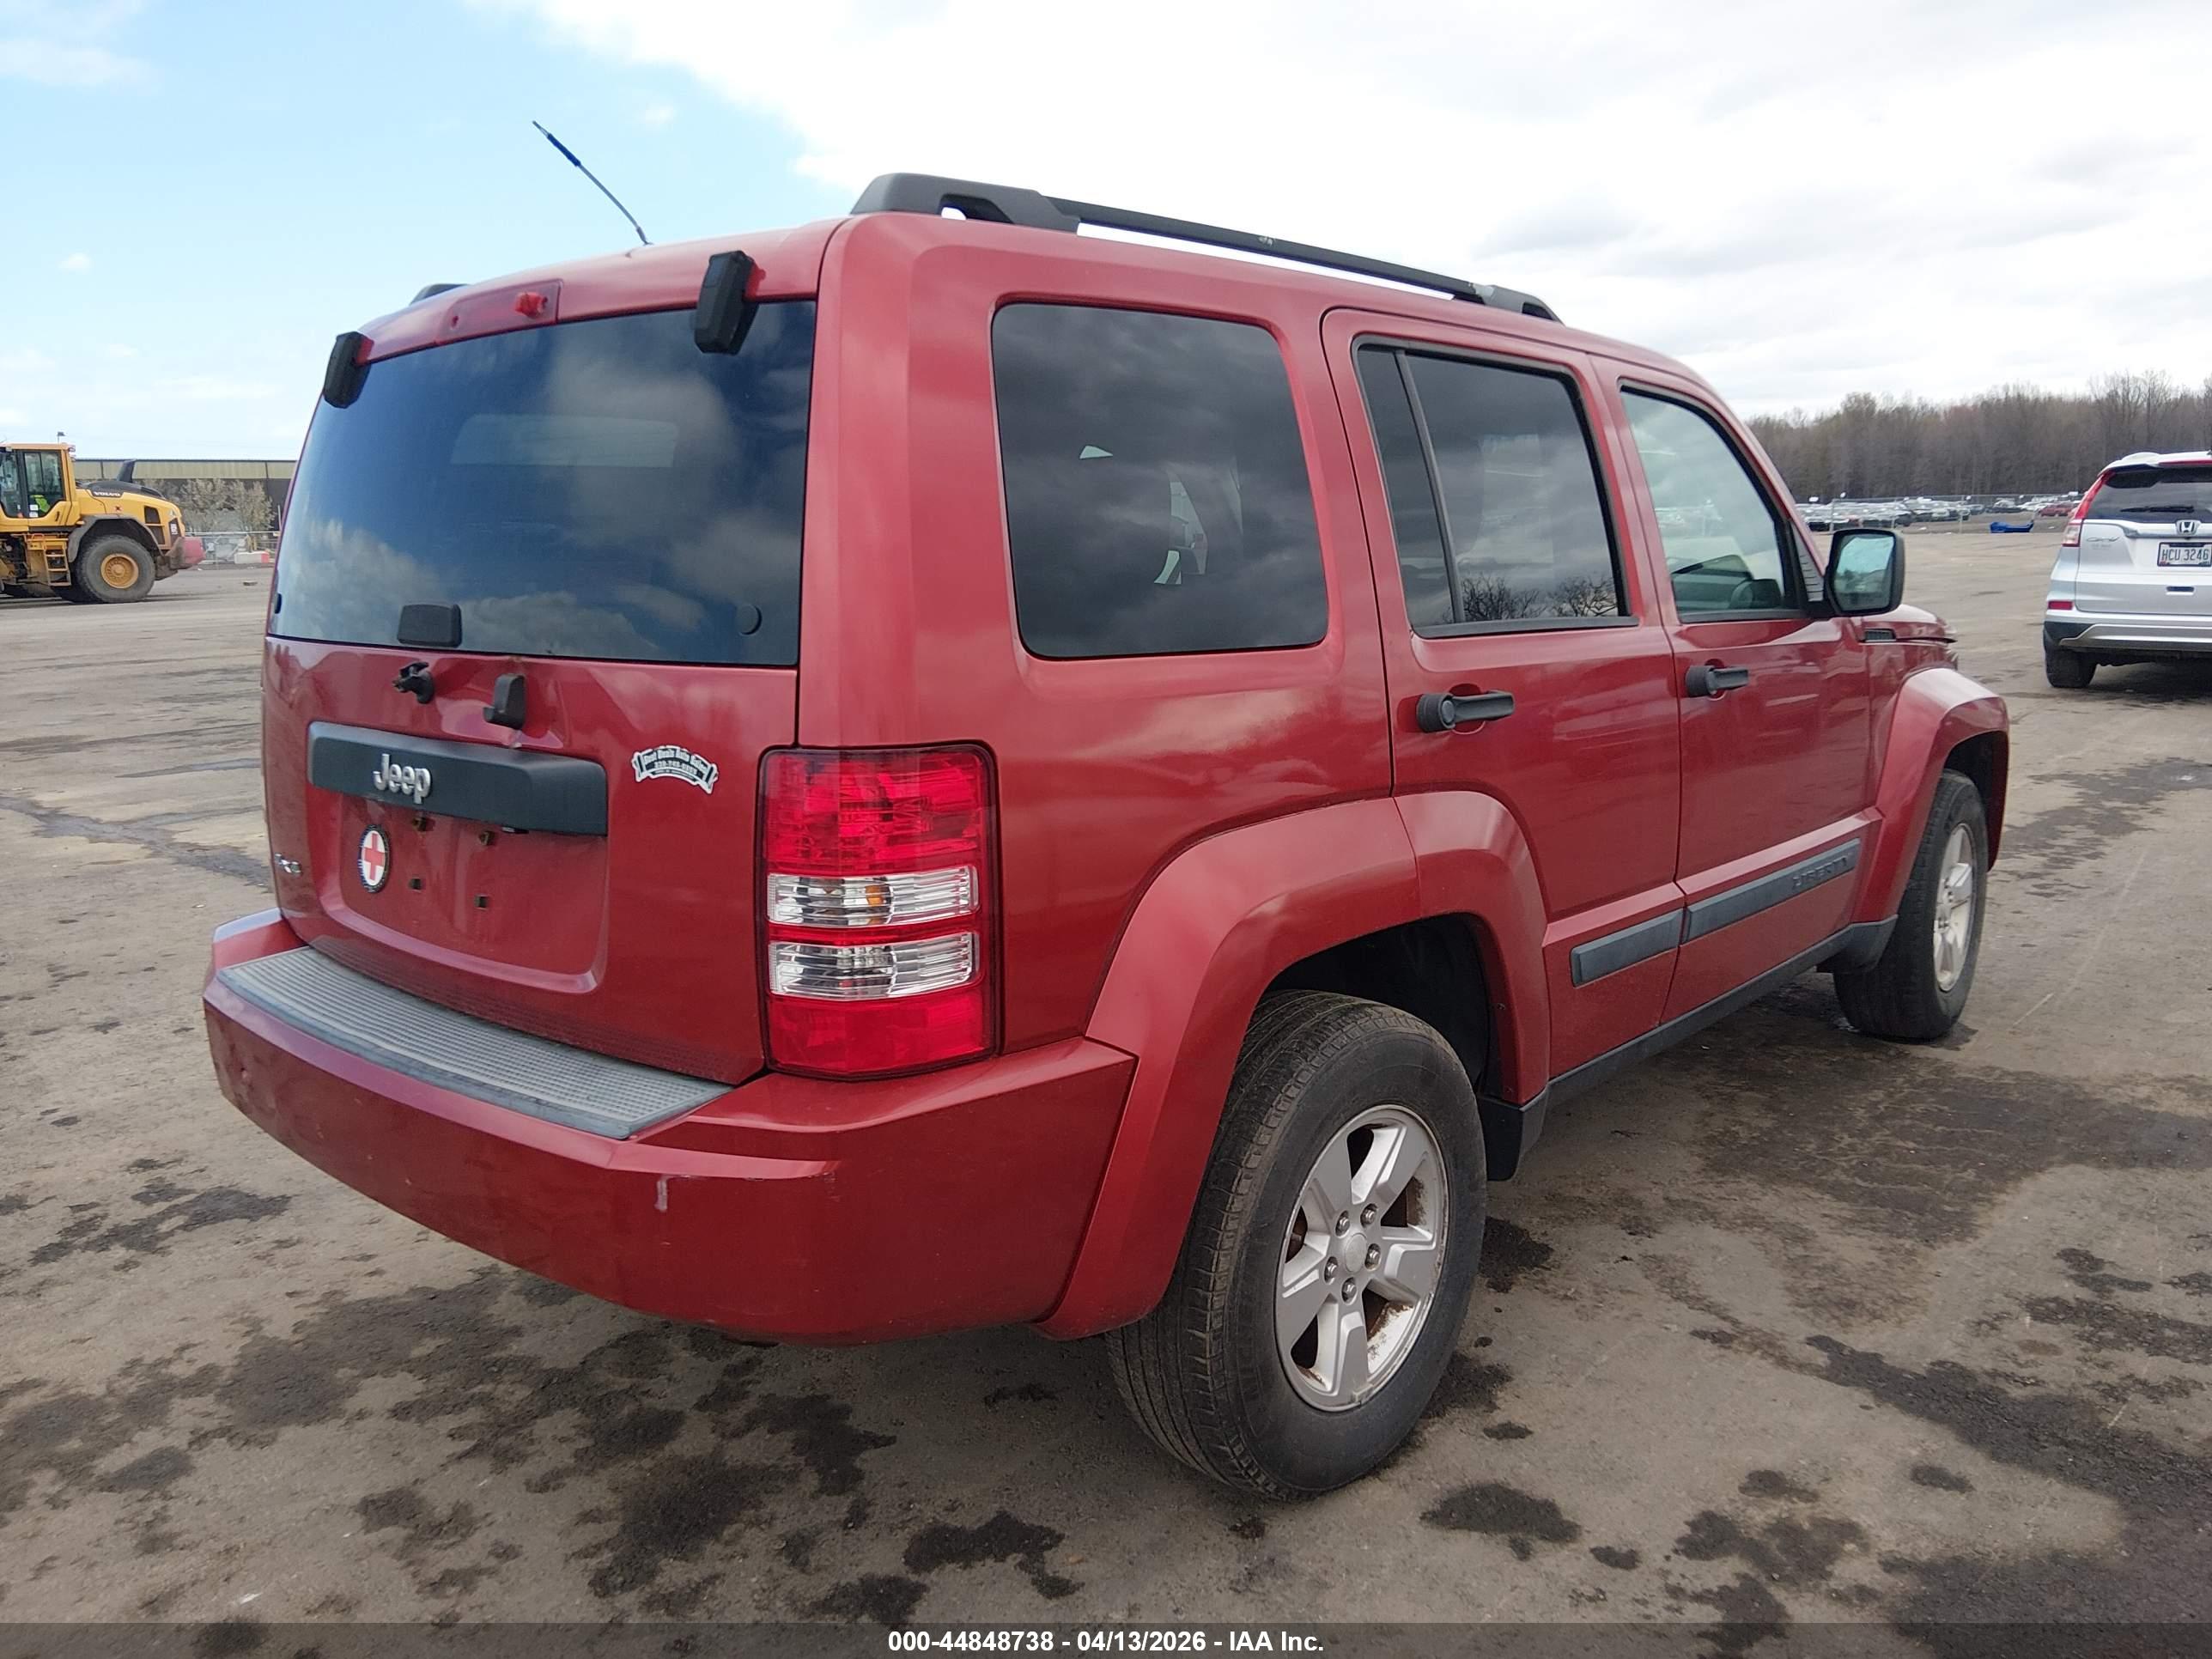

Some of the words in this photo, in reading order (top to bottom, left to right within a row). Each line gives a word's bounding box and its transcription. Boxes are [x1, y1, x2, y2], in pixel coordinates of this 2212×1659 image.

[2161, 549, 2181, 561] HCU
[2184, 549, 2209, 561] 3246
[373, 753, 432, 805] Jeep
